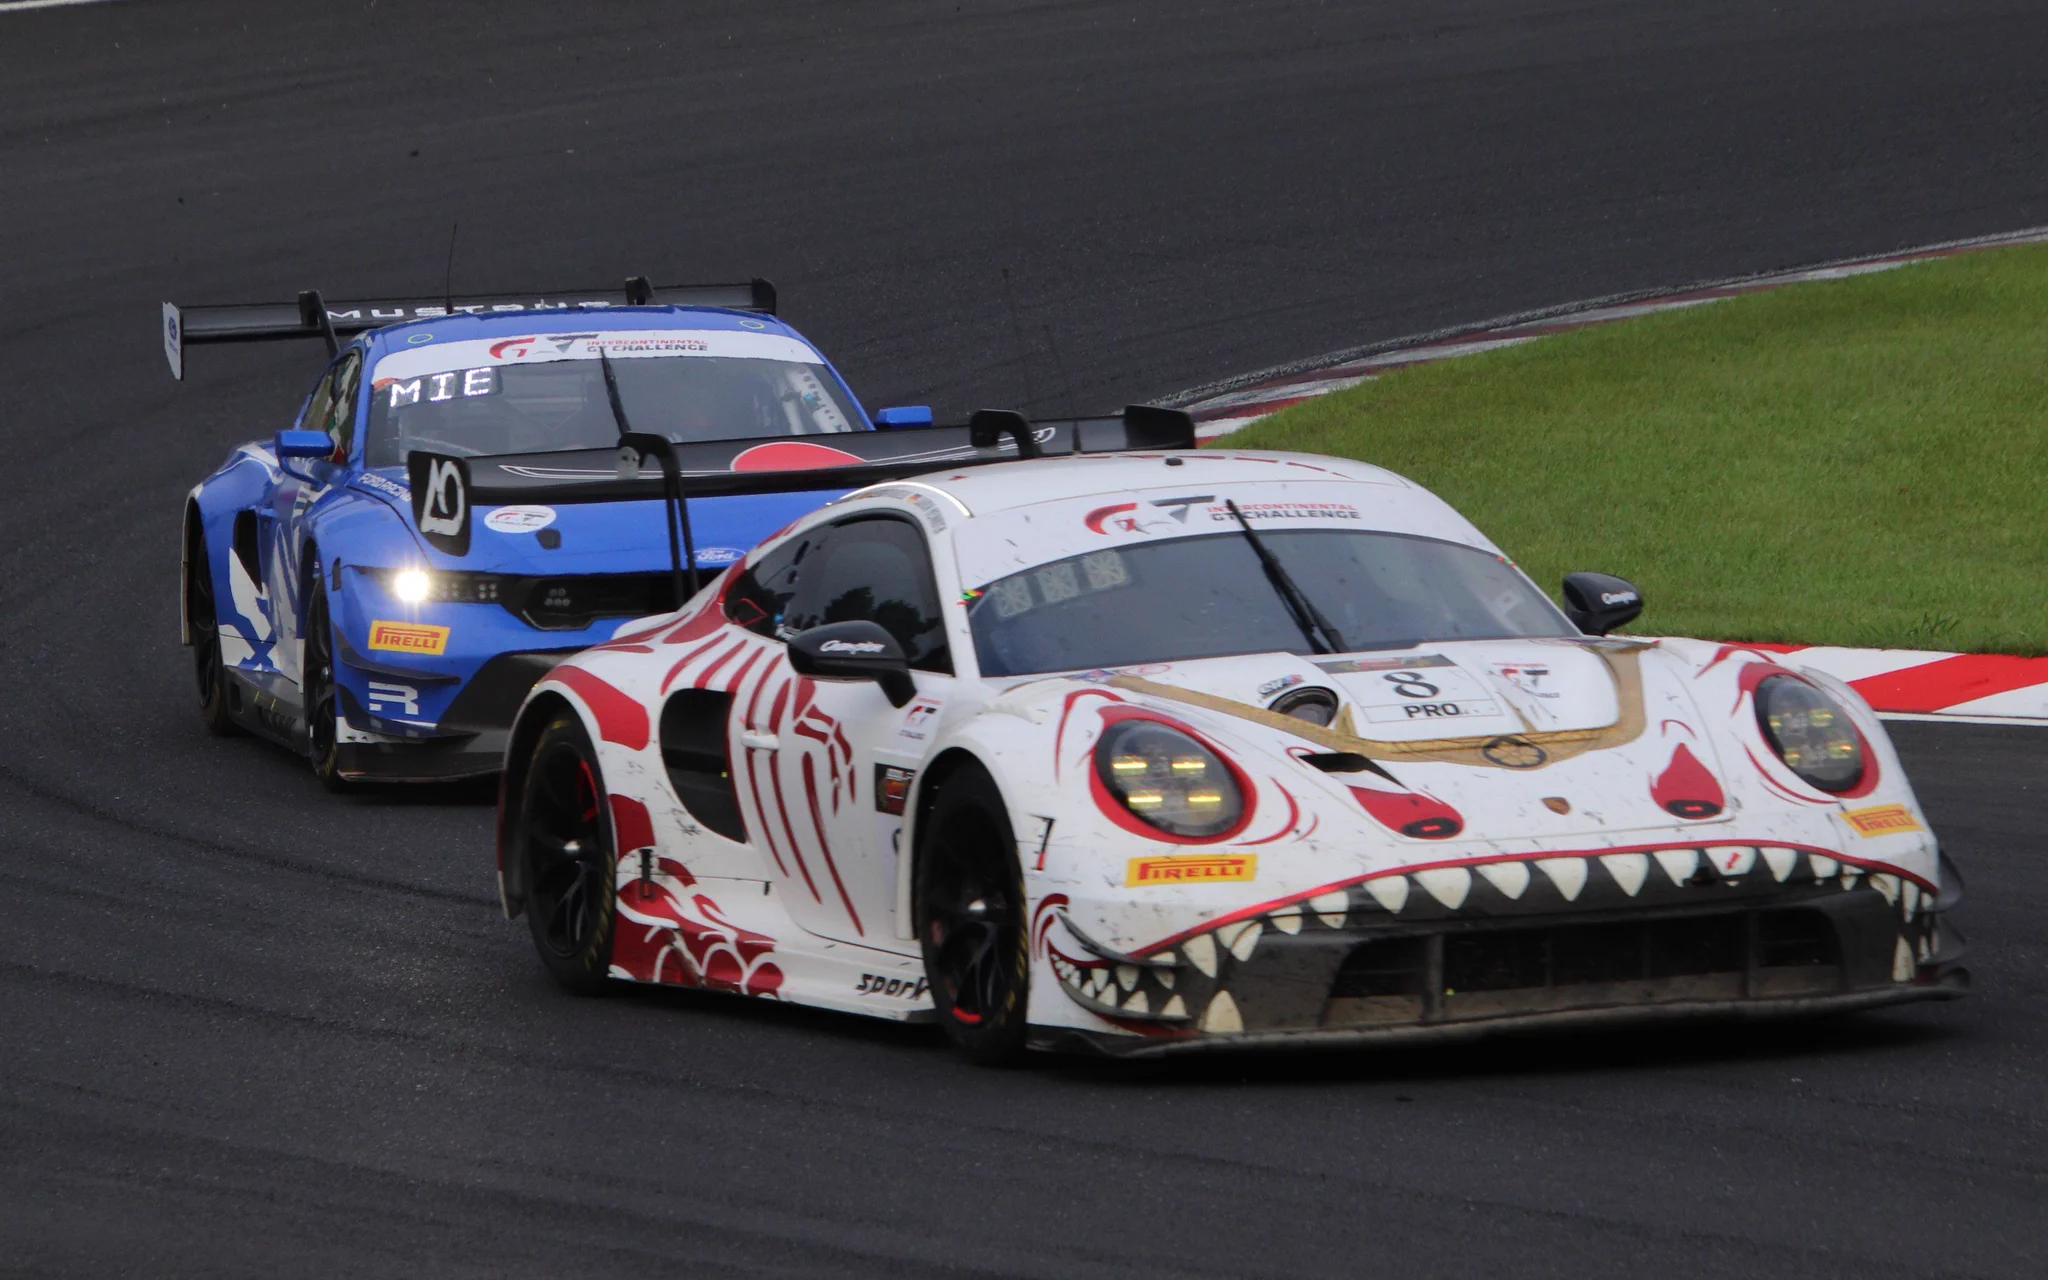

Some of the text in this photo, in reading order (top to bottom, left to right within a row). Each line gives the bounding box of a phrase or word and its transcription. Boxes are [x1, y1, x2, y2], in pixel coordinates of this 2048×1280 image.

[612, 344, 708, 352] CHALLENGE
[389, 366, 492, 408] MIE
[1242, 509, 1362, 520] CHALLENGE
[375, 626, 441, 649] PIRELLI
[1383, 671, 1440, 699] 8
[1404, 702, 1460, 719] PRO
[1850, 809, 1917, 832] PIRELLI
[1138, 859, 1246, 881] PIRELLI
